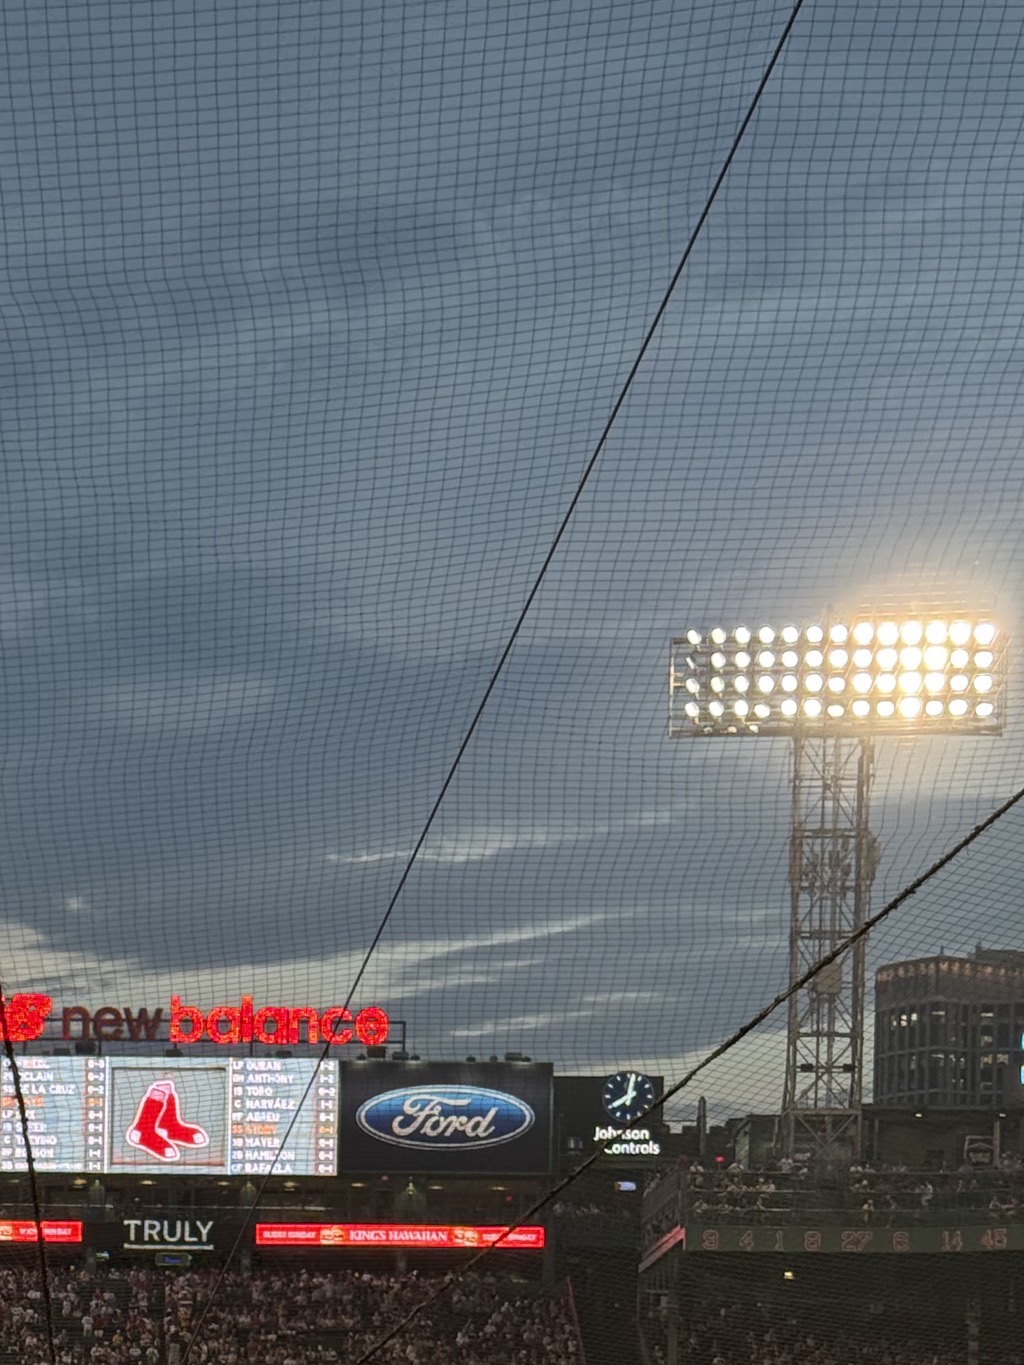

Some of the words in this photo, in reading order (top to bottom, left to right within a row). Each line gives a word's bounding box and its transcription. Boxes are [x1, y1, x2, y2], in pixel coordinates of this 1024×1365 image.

[62, 1006, 164, 1040] new
[170, 994, 389, 1046] balance
[247, 1074, 293, 1084] ANTHONY
[392, 1094, 495, 1138] Ford
[123, 1219, 214, 1242] TRULY
[389, 1229, 449, 1242] HAWAIIAN
[703, 1230, 719, 1250] 9
[774, 1231, 784, 1250] 1
[804, 1231, 822, 1250] 8
[941, 1230, 962, 1251] 14
[980, 1229, 1008, 1249] 45
[739, 1231, 755, 1251] 4
[841, 1231, 873, 1251] 27
[893, 1232, 910, 1251] 6
